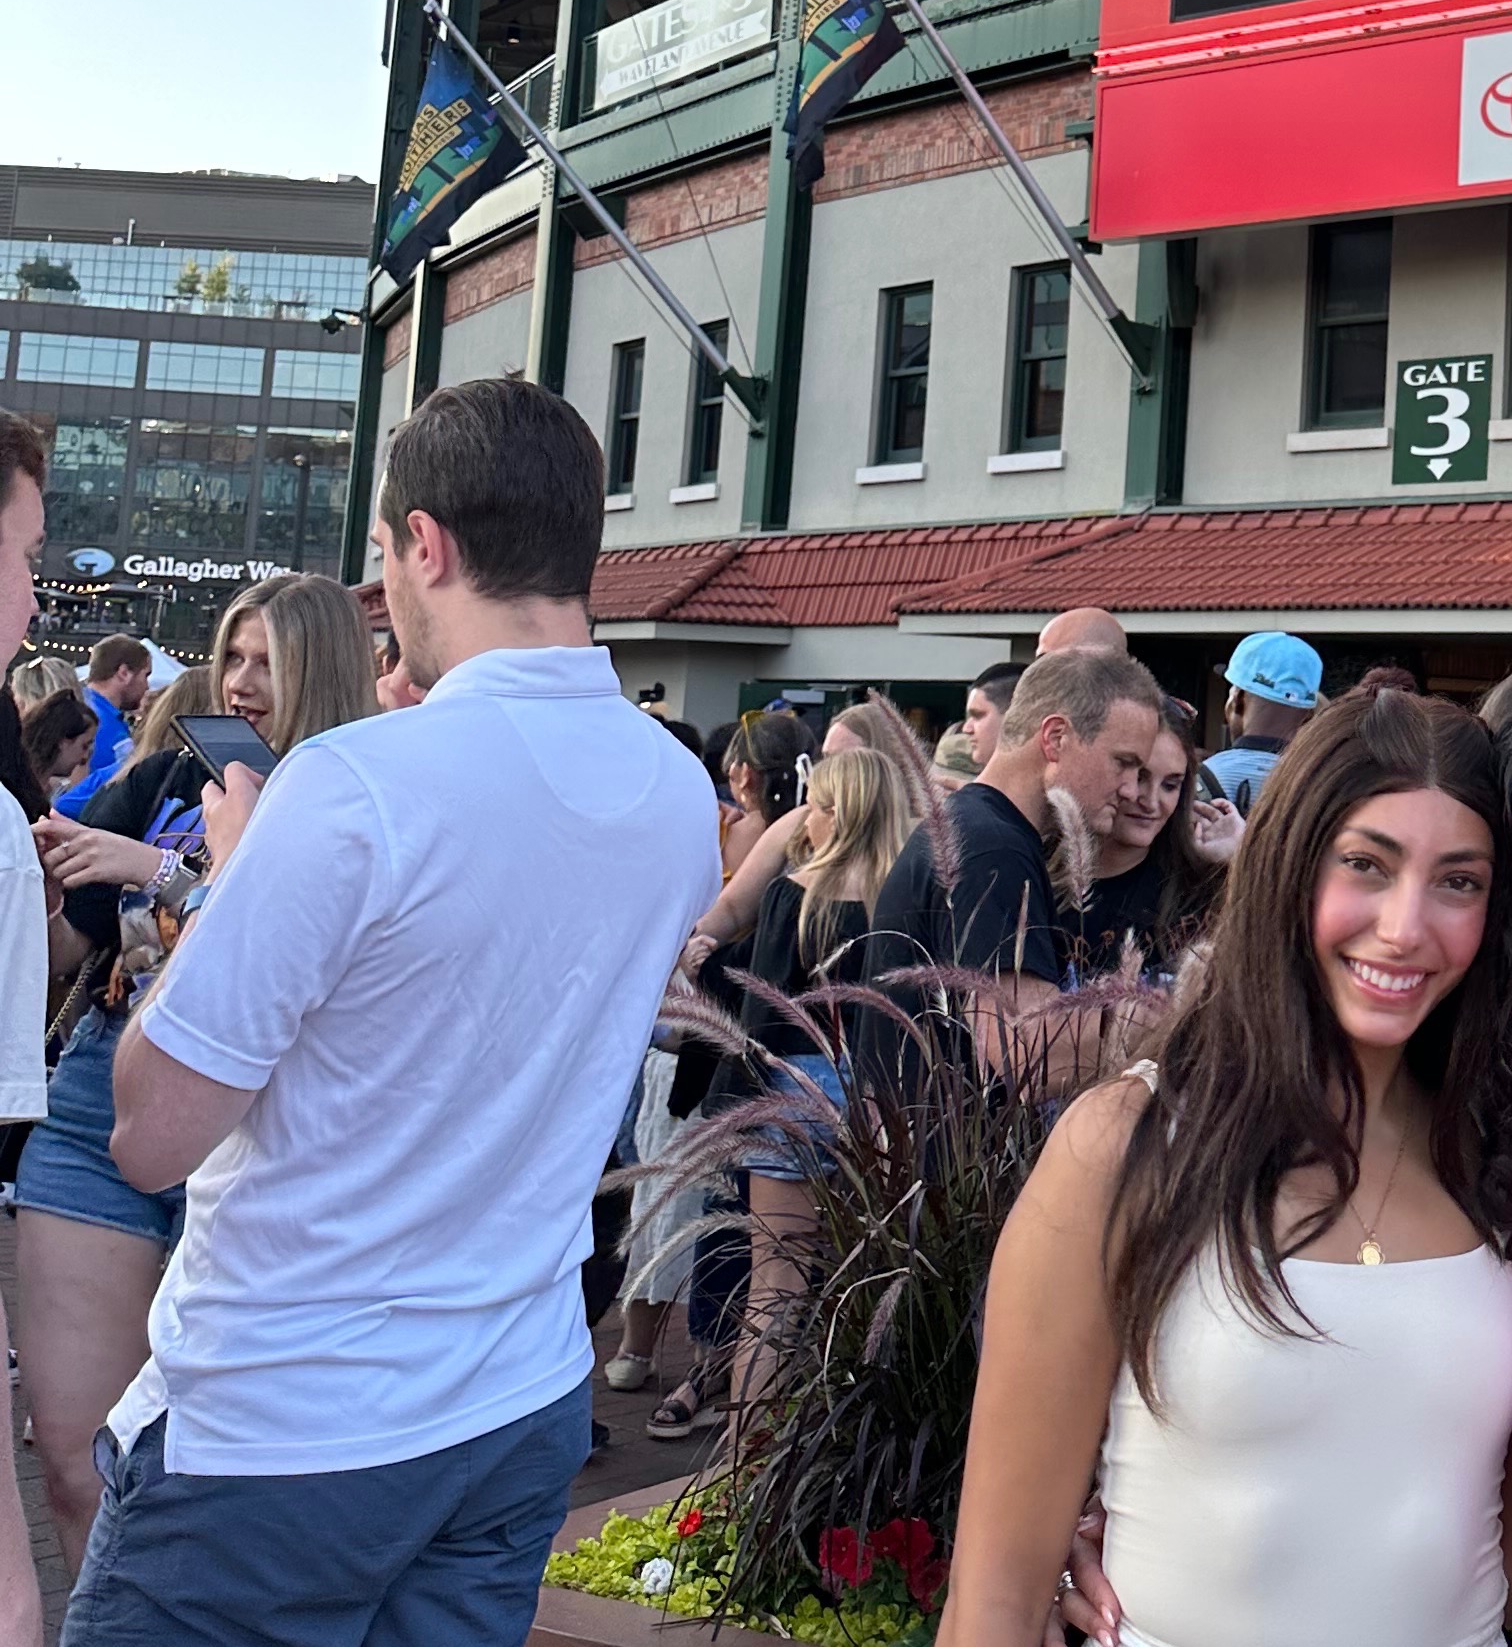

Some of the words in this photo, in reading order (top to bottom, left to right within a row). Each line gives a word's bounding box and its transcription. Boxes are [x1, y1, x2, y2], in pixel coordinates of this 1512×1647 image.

[1403, 360, 1485, 387] GATE
[1410, 387, 1471, 457] 3
[123, 554, 244, 582] Gallagher
[246, 561, 291, 581] Wa
